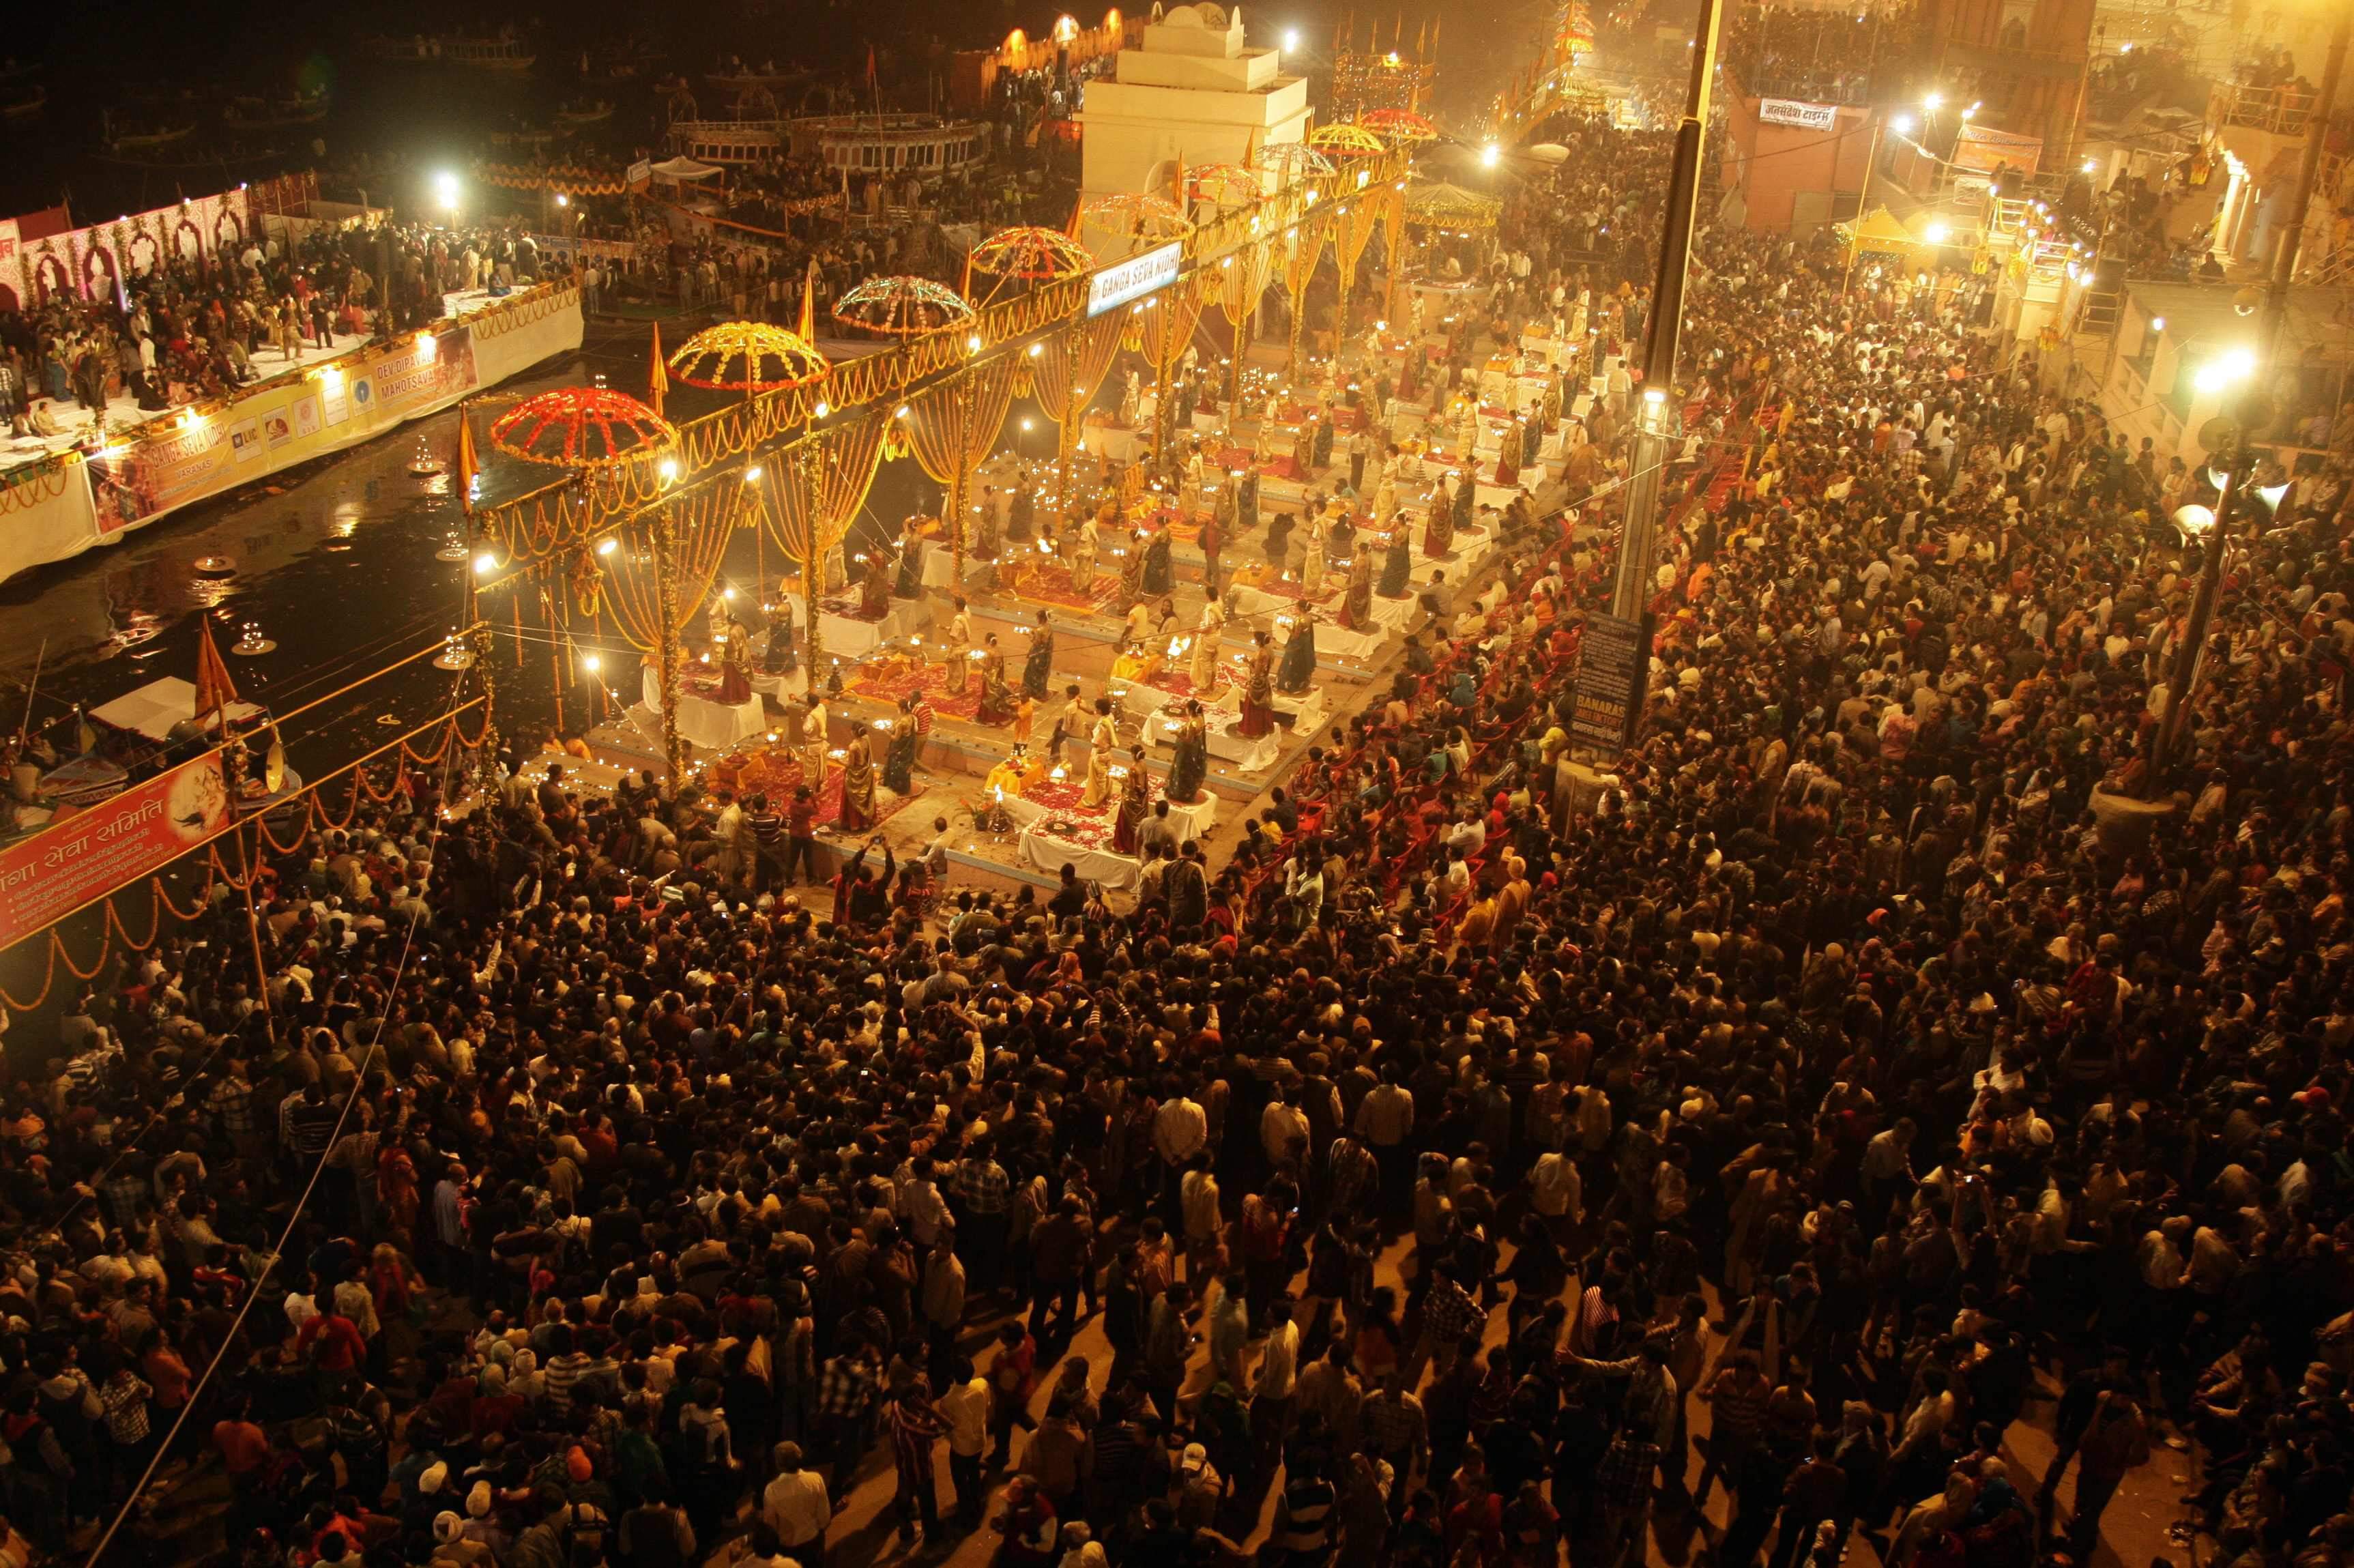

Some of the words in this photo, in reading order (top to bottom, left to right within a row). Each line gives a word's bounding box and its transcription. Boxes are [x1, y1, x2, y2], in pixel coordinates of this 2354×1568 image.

[1102, 269, 1130, 298] GANGA
[1133, 259, 1154, 286] SEVA
[1156, 248, 1180, 274] NIDHI
[381, 369, 435, 400] MAHOTSAVA
[181, 430, 206, 456] SEVA
[243, 427, 257, 444] LIC
[44, 835, 90, 868] सेवा
[97, 798, 164, 842] समिति
